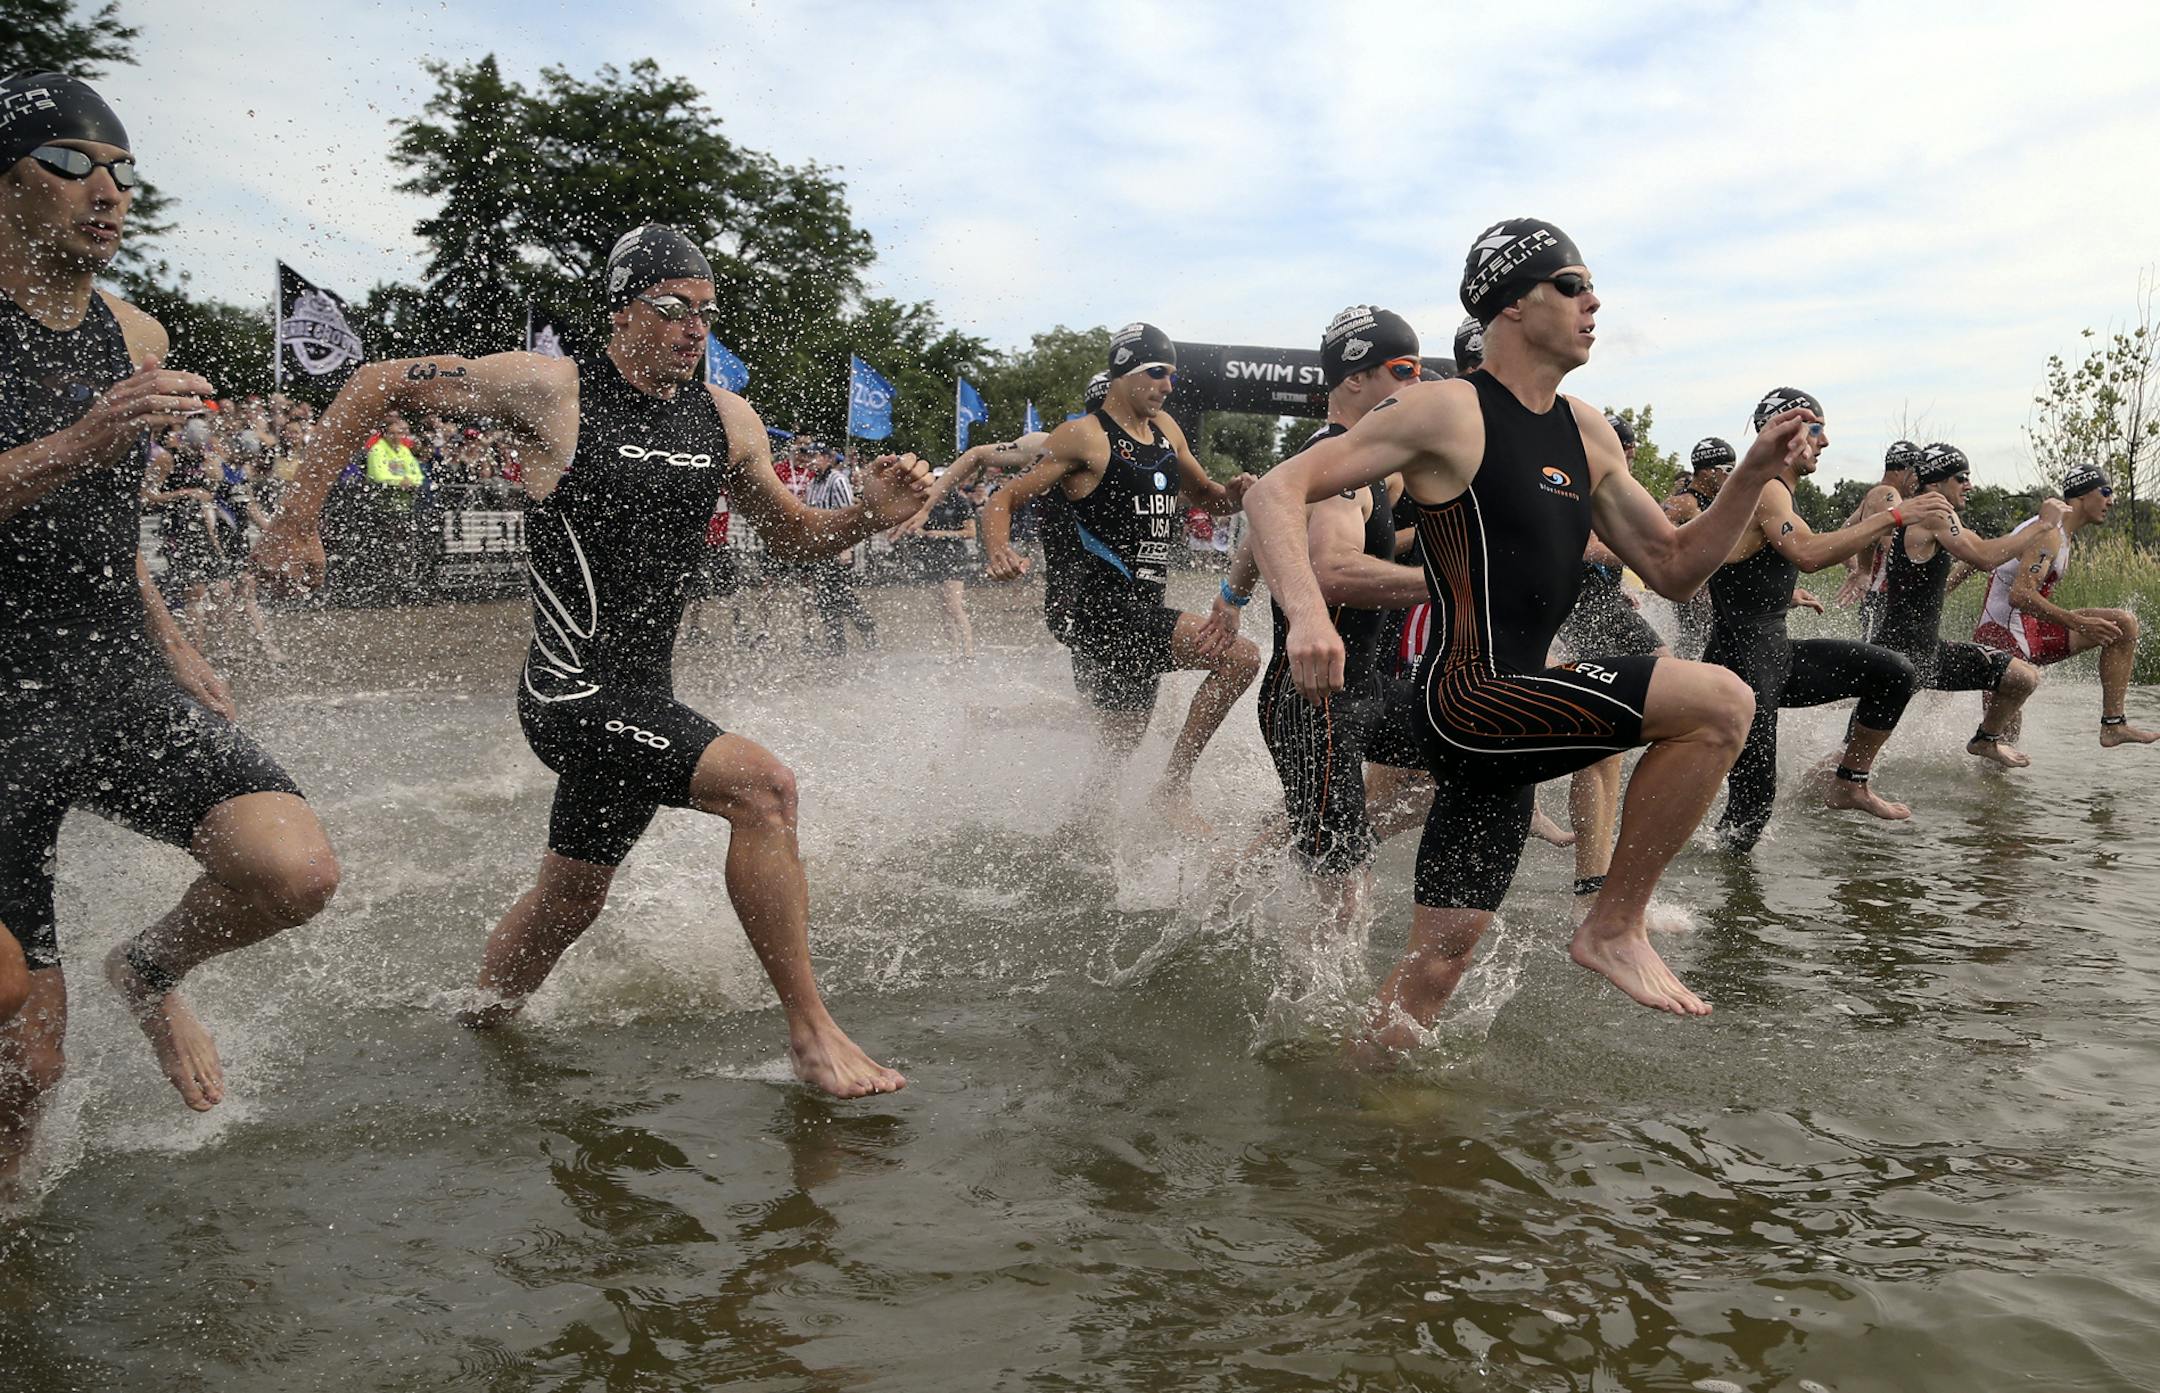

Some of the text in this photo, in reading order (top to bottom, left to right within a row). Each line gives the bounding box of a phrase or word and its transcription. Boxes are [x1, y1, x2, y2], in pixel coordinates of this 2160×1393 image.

[1465, 229, 1550, 297] XTERRA
[1470, 237, 1558, 305] WETSUITS
[1353, 323, 1378, 336] TOYOTA
[1225, 360, 1328, 386] SWIM ST
[618, 444, 712, 469] orca
[1151, 518, 1170, 538] USA
[604, 719, 671, 750] orca
